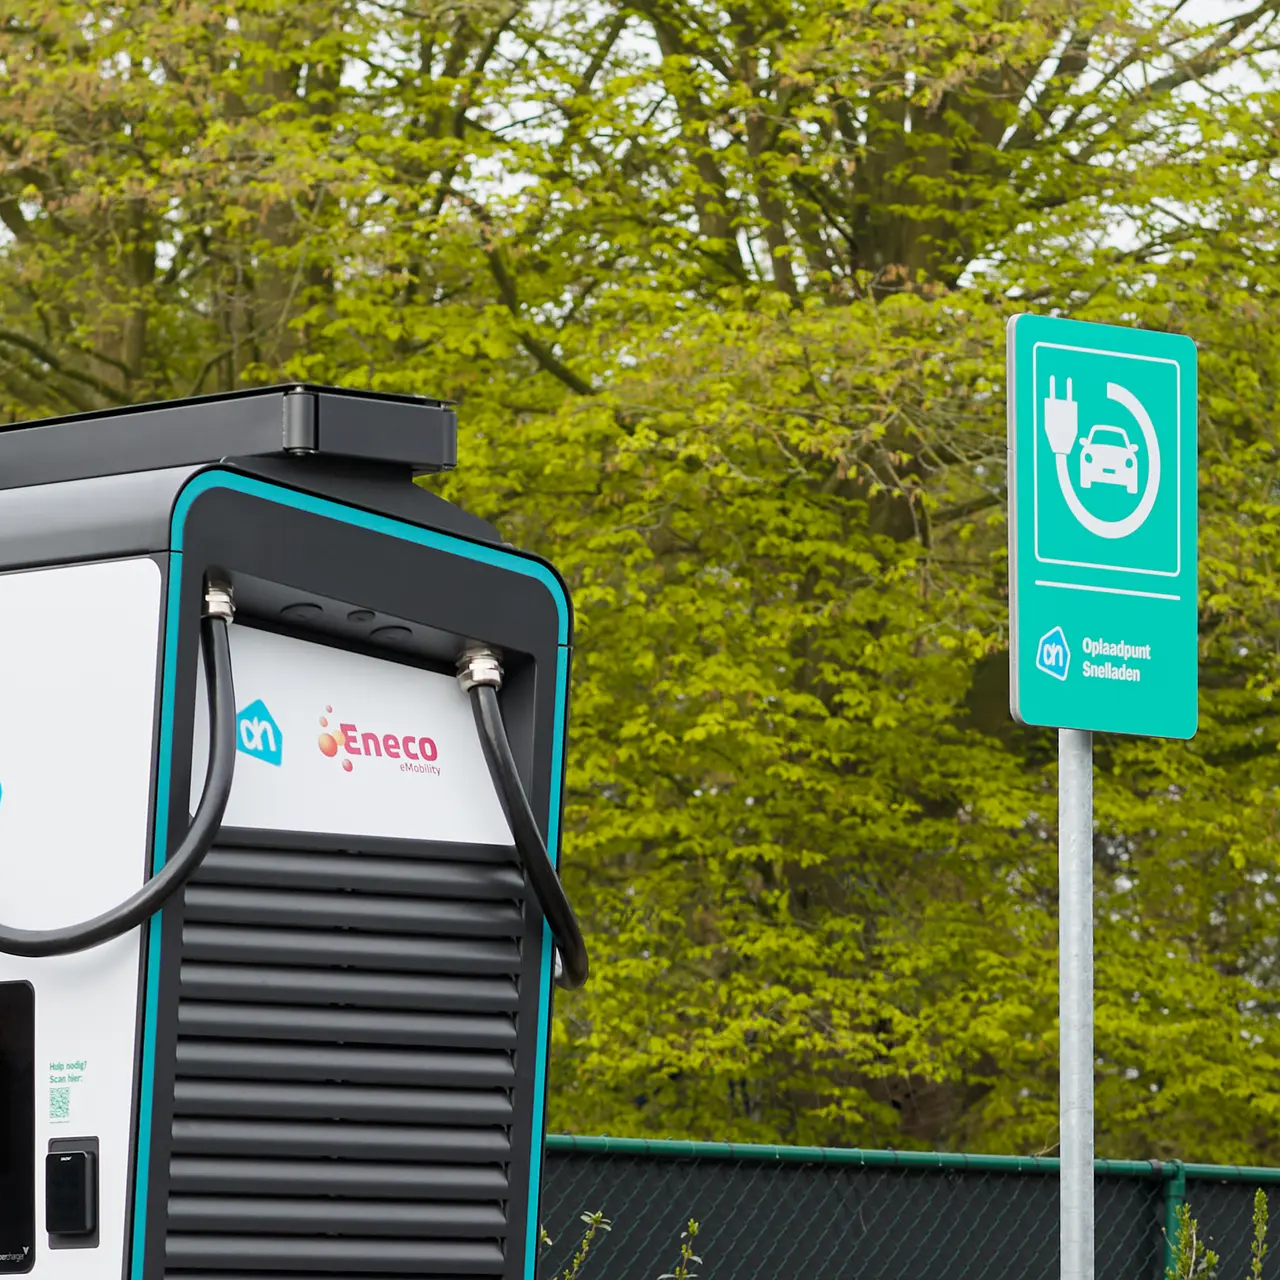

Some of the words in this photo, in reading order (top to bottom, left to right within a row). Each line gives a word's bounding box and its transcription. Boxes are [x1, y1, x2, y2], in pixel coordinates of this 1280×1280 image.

[1082, 637, 1152, 661] Oplaadpunt
[1082, 661, 1141, 682] Snelladen
[339, 723, 439, 762] Eneco
[399, 762, 441, 776] eMobility
